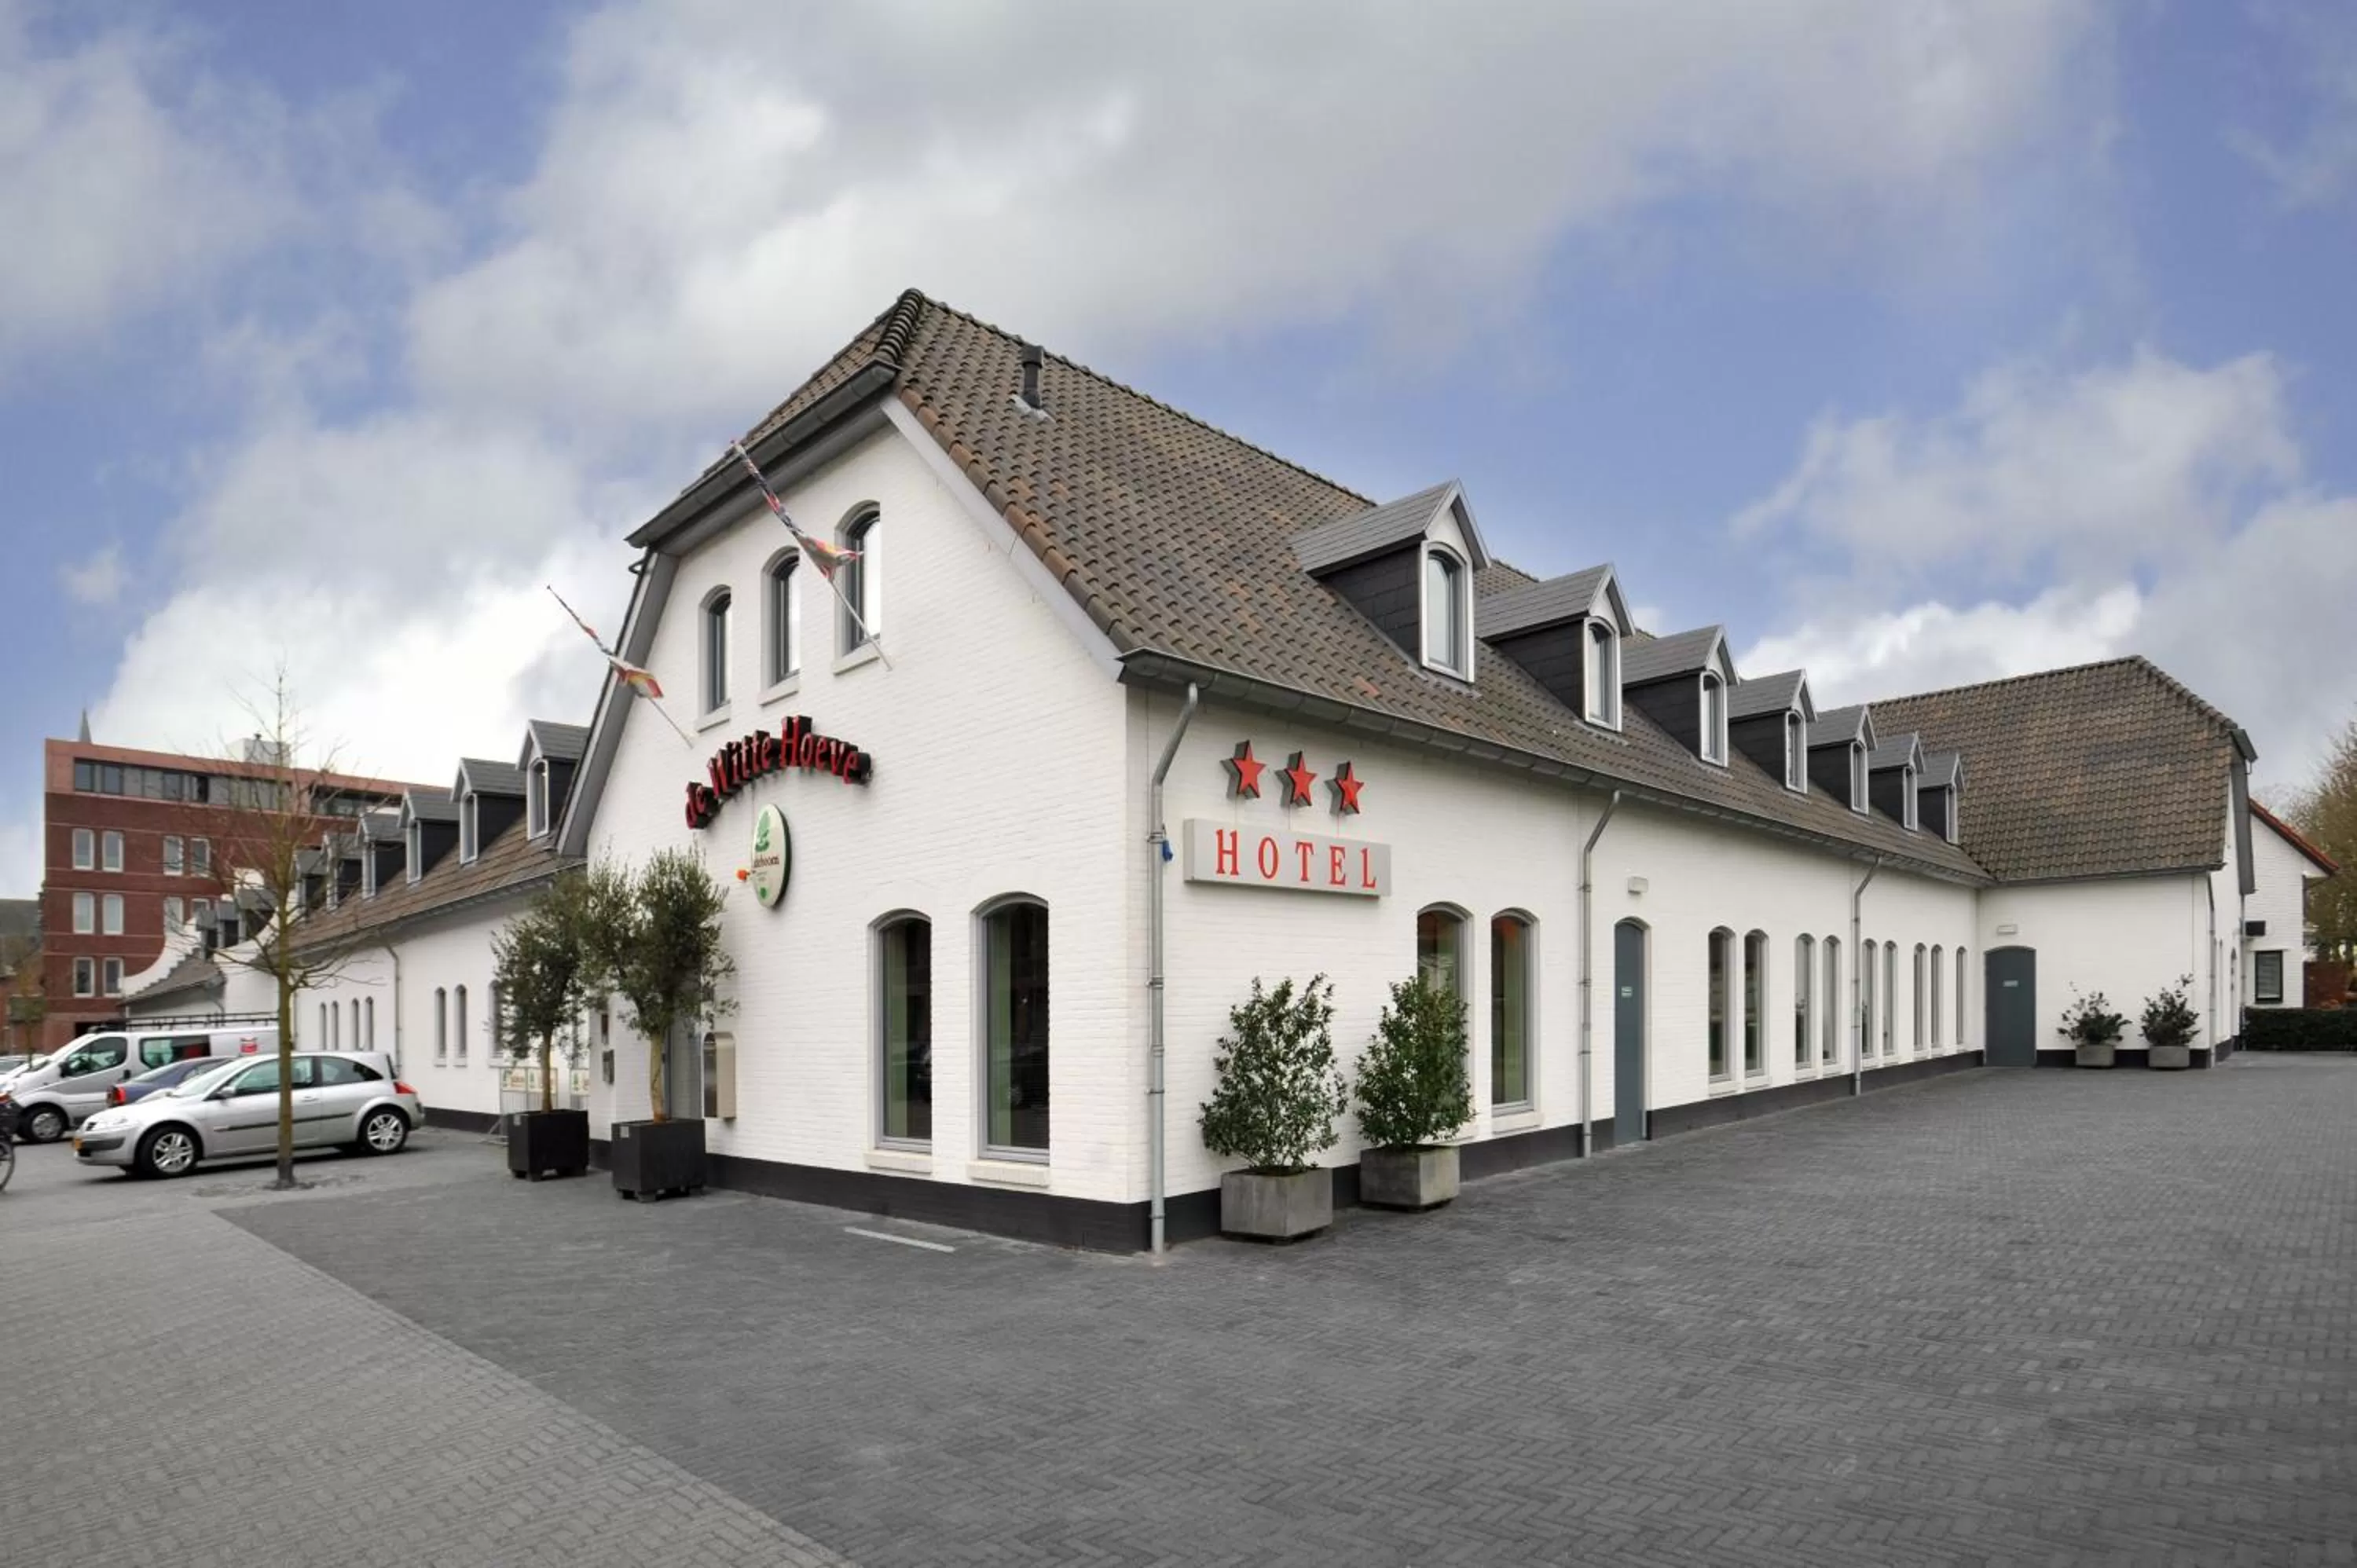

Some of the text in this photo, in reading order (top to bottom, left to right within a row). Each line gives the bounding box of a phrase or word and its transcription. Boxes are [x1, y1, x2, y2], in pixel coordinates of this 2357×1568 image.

[708, 735, 772, 798] Witte
[779, 715, 860, 784] Hoeve
[1215, 829, 1376, 888] HOTEL
